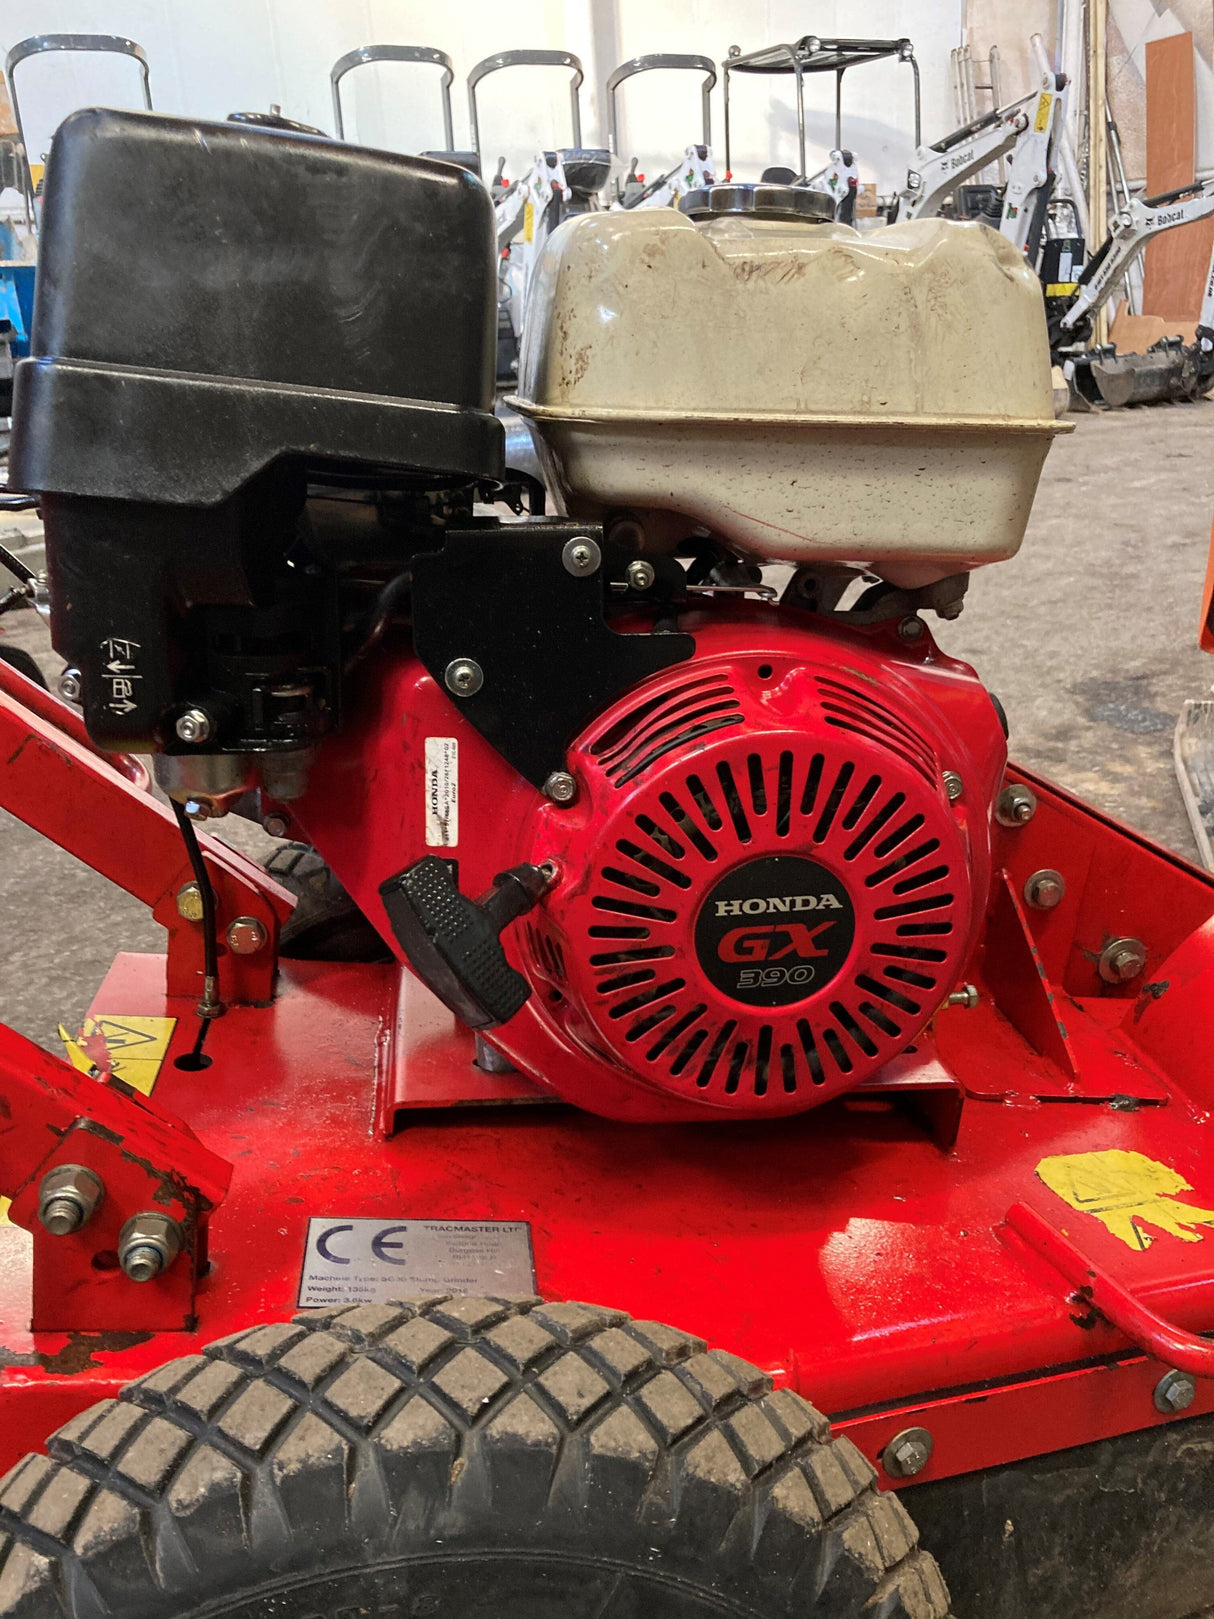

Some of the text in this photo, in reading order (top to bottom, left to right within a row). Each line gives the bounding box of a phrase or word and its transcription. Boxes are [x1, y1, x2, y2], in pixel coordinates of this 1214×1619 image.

[952, 149, 974, 169] Bobcat
[1157, 210, 1184, 226] Bobcat
[715, 893, 843, 917] HONDA
[717, 920, 838, 963] GX
[736, 965, 815, 989] 390
[423, 1225, 500, 1233] TRACMASTER
[307, 1285, 344, 1294] Weight:
[305, 1296, 341, 1304] Power:
